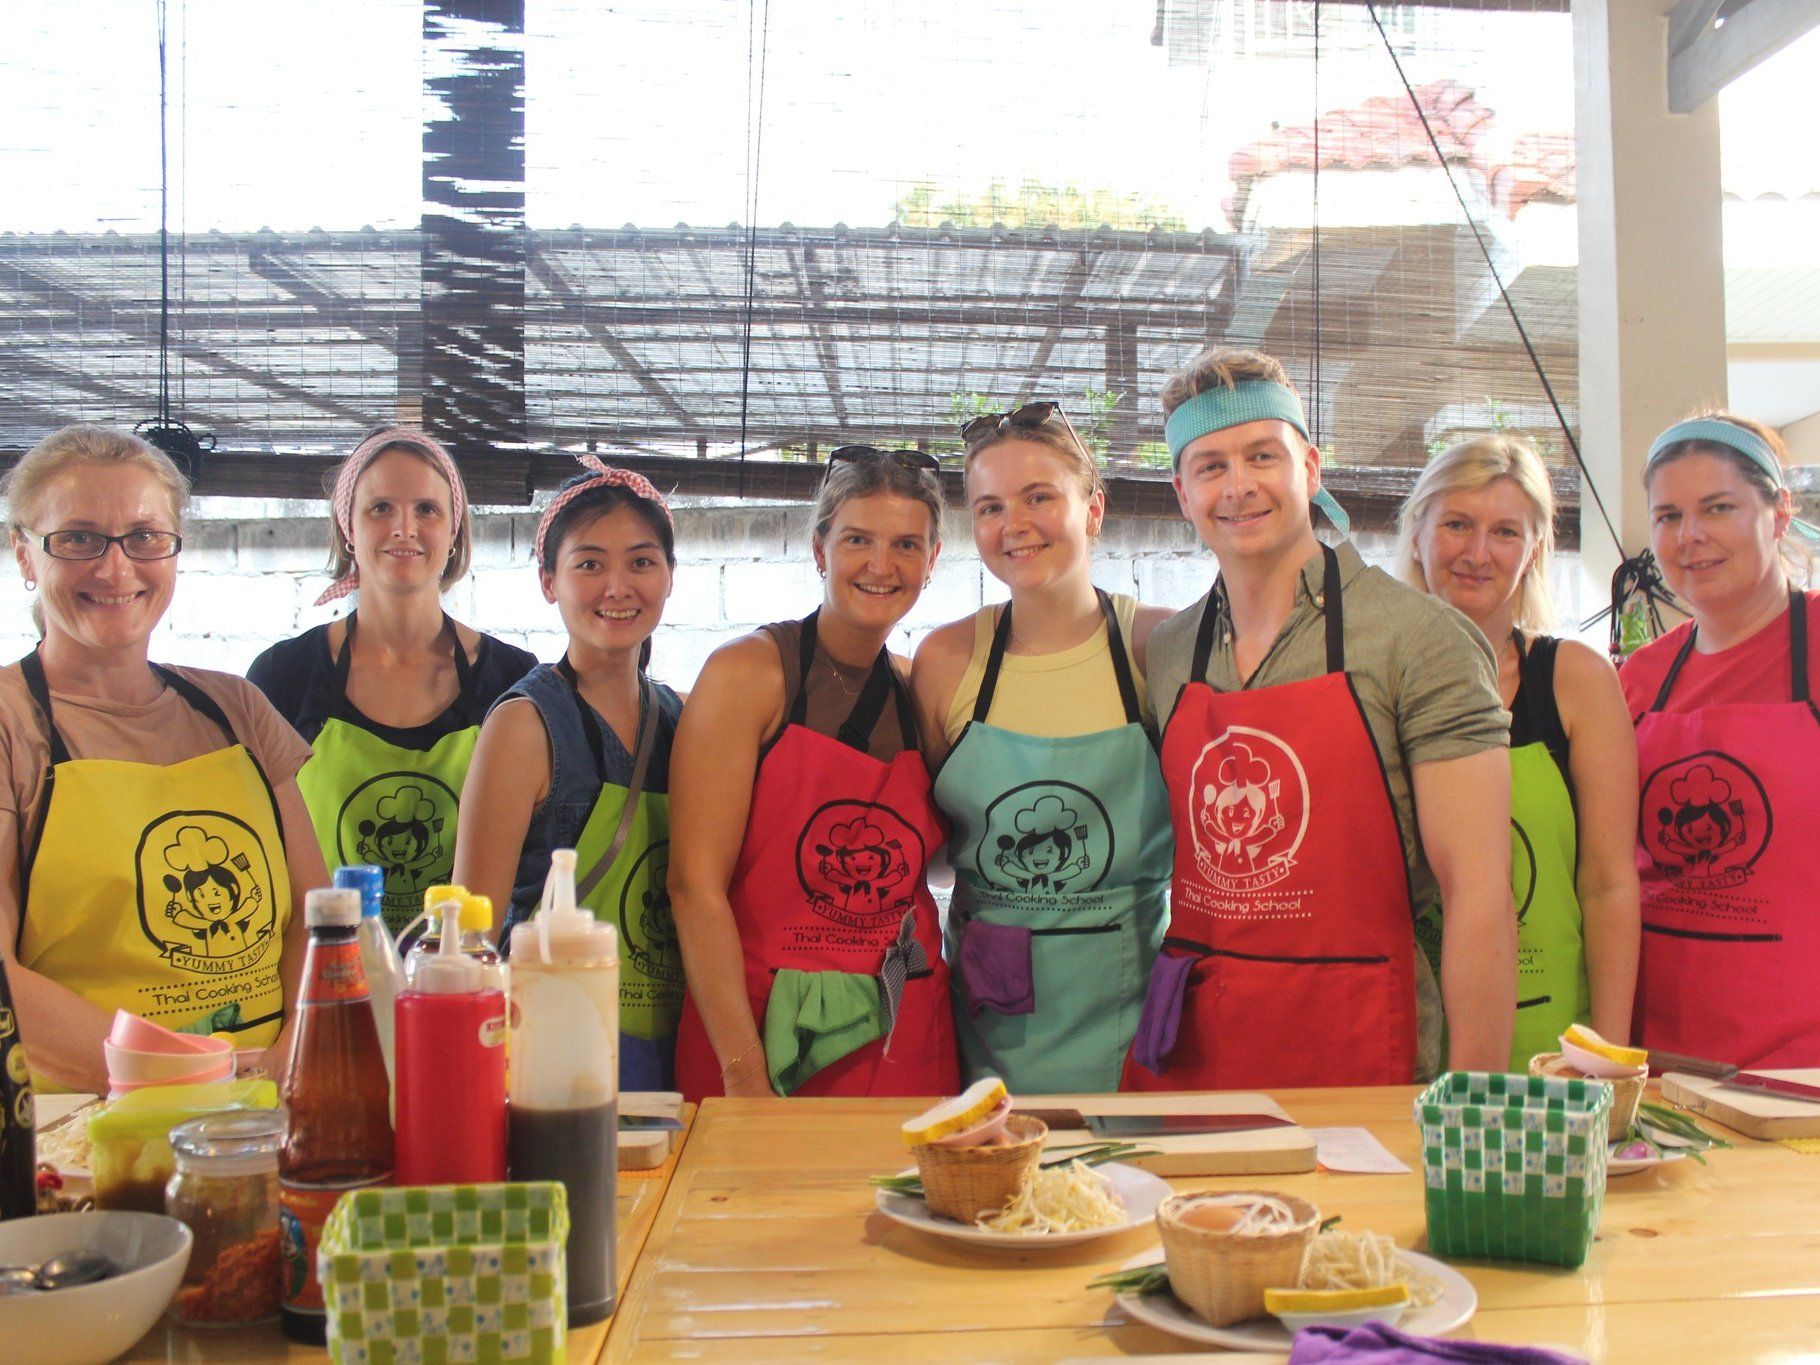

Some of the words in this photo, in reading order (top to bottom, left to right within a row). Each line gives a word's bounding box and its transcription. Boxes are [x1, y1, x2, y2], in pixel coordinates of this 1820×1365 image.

[1202, 862, 1239, 889] YUMMY
[1243, 867, 1280, 889] TASTY
[1006, 893, 1057, 905] Cooking
[1062, 894, 1104, 905] School
[1185, 888, 1201, 903] Thai
[1203, 896, 1250, 914] Cooking
[1253, 899, 1301, 912] School
[1711, 900, 1758, 914] School
[822, 906, 868, 927] YUMMY
[871, 910, 901, 927] TASTY
[793, 932, 821, 943] Thai
[826, 934, 880, 947] Cooking
[181, 955, 234, 973] YUMMY
[640, 961, 676, 979] YUMM
[153, 990, 191, 1006] Thai
[196, 980, 252, 1001] Cooking
